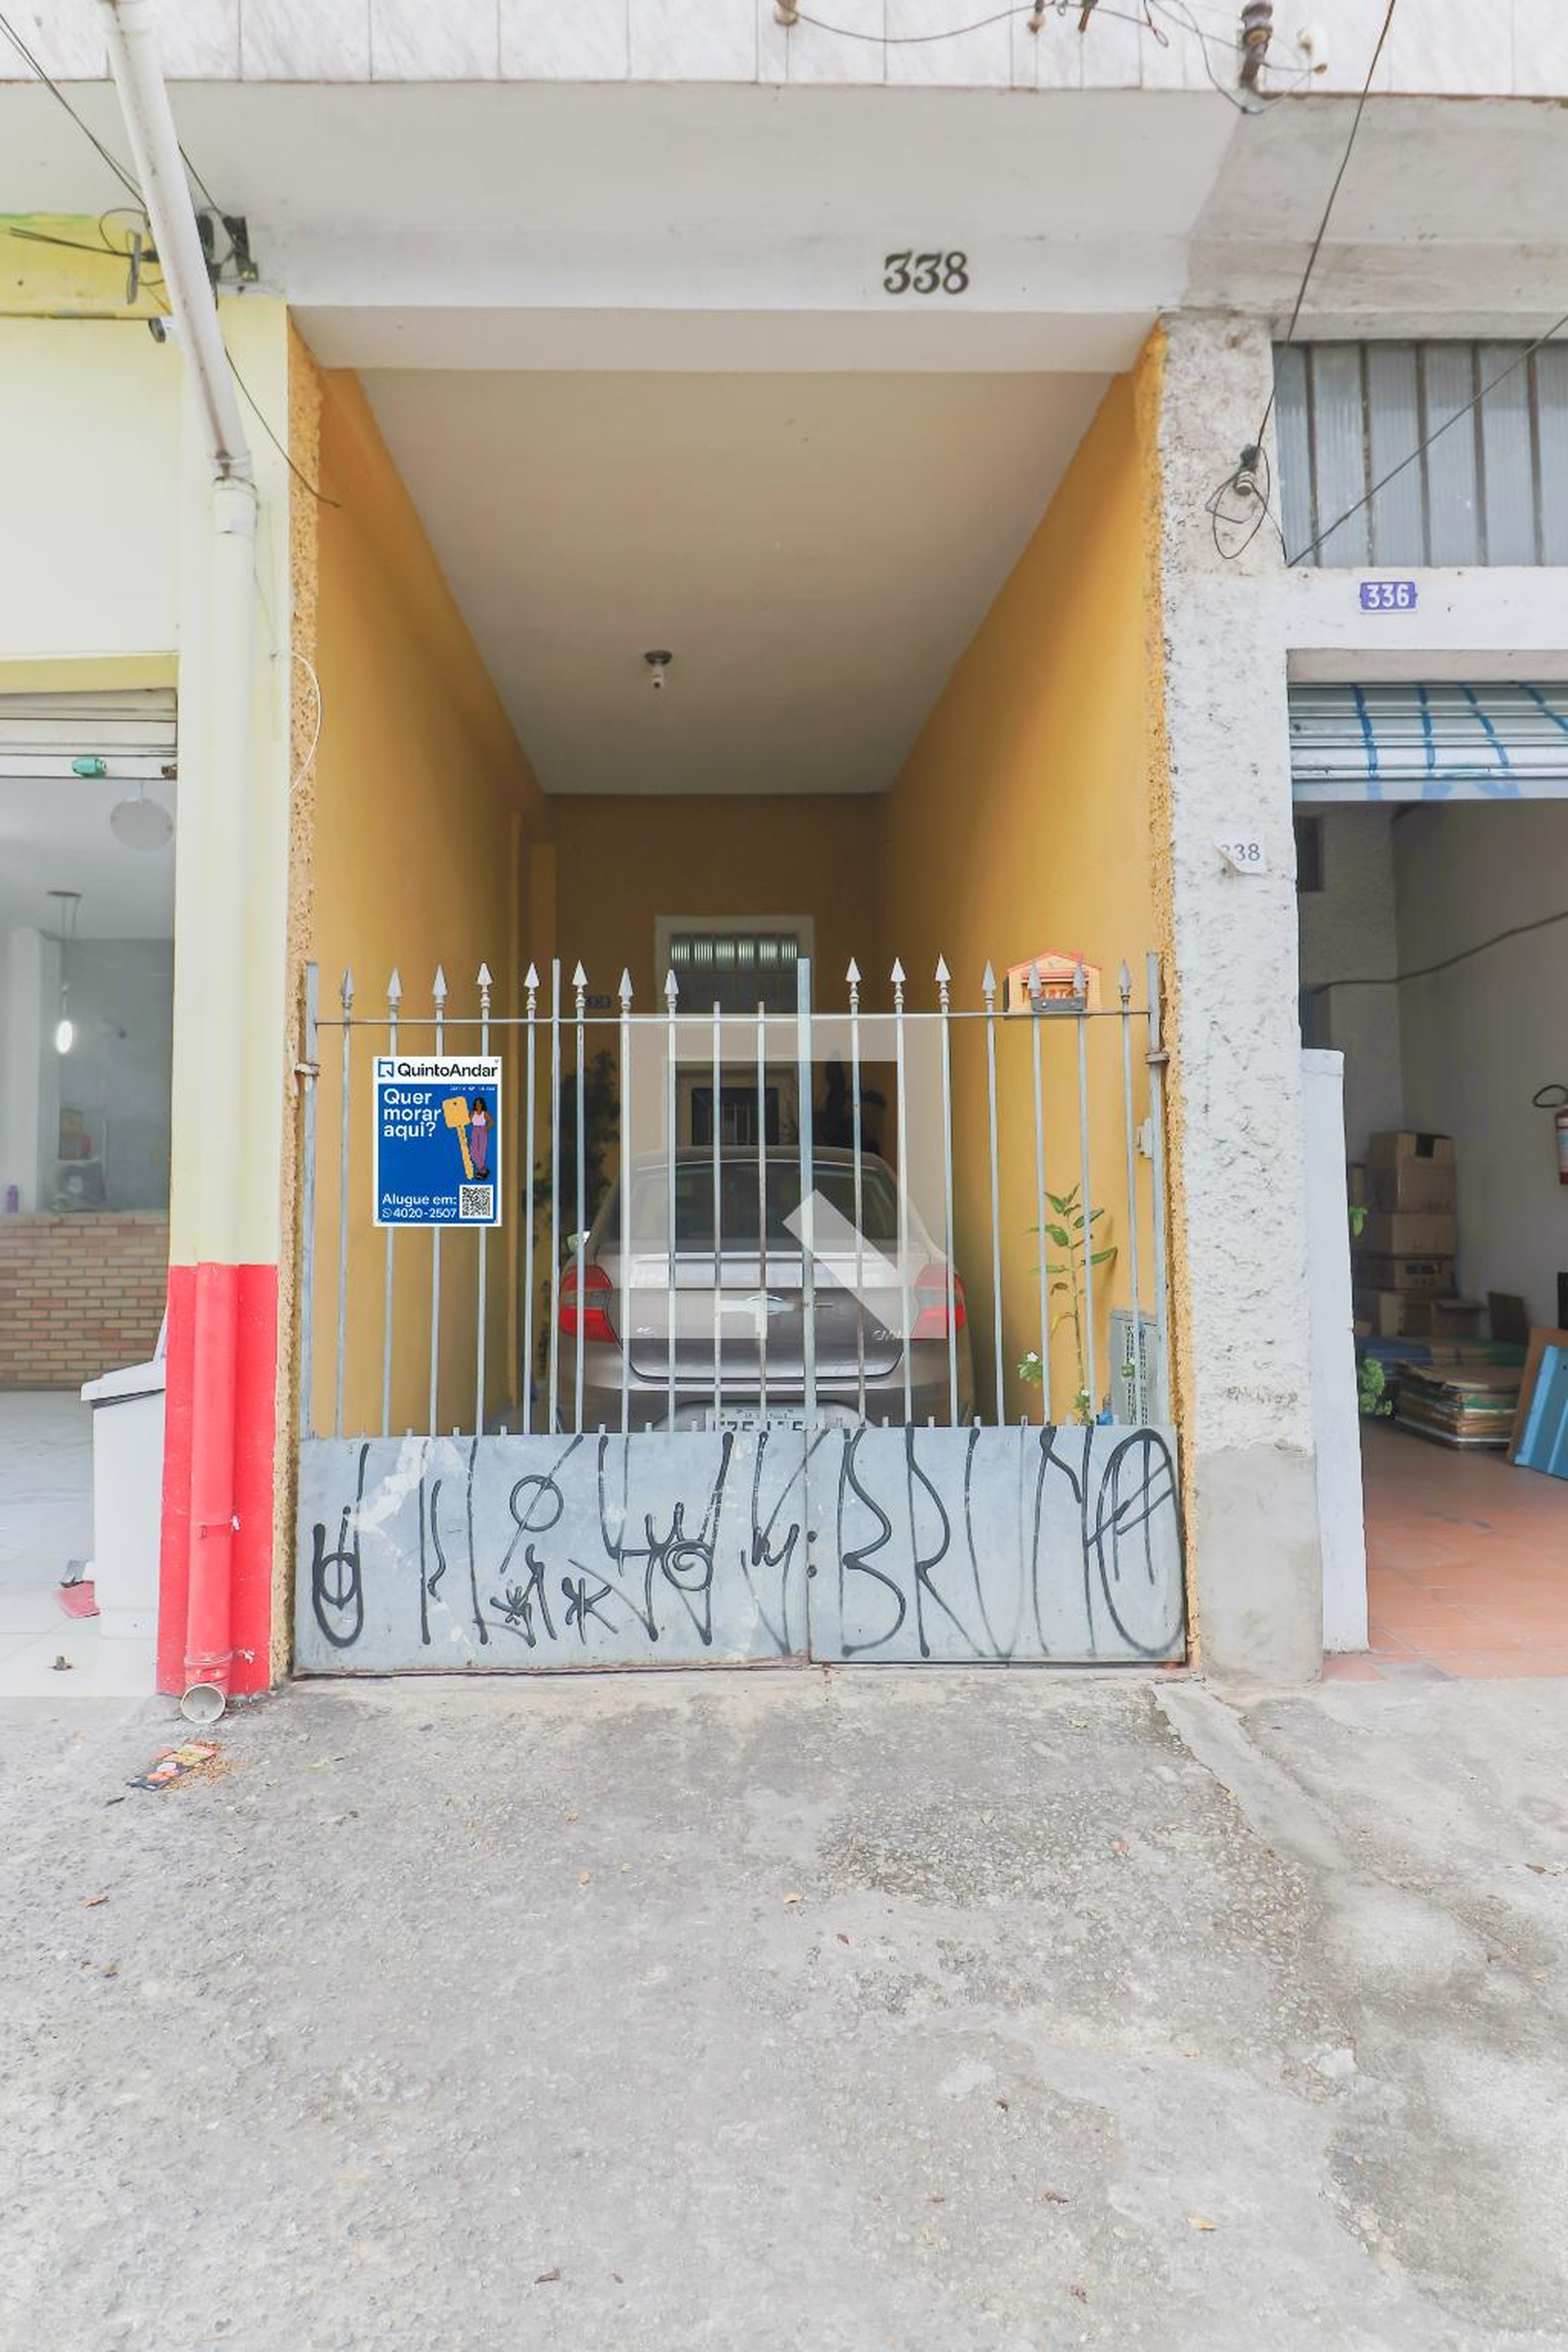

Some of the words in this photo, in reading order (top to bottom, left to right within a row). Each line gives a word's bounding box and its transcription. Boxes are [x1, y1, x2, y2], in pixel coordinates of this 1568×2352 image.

[883, 249, 969, 294] 338
[1367, 584, 1409, 608] 336
[397, 1062, 498, 1077] QuintoAndar
[383, 1088, 432, 1105] Quer
[383, 1108, 441, 1121] morar
[383, 1122, 436, 1141] aqui?
[382, 1193, 429, 1207] Alugue
[433, 1196, 457, 1205] em:
